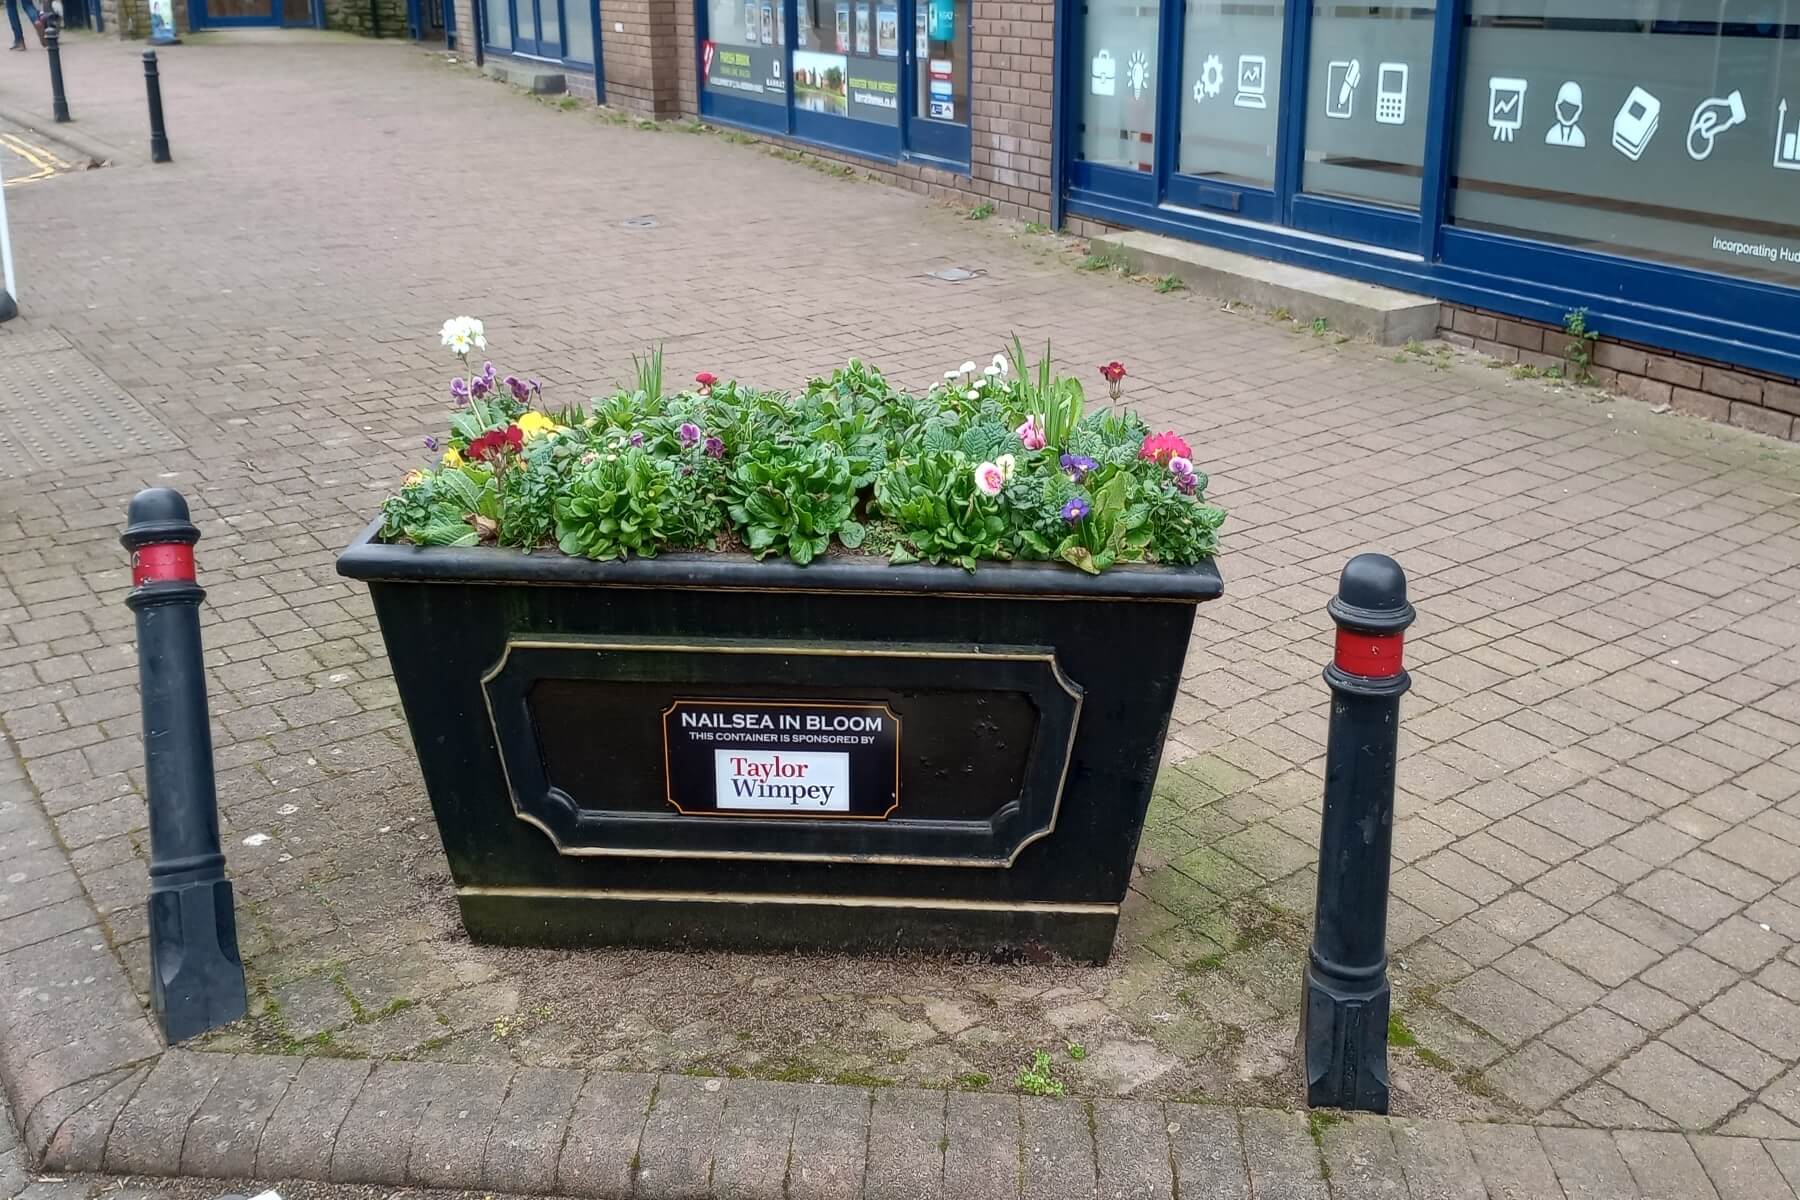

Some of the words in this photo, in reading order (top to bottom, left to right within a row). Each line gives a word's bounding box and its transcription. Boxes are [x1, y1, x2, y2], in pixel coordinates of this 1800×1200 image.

[1713, 236, 1777, 261] Incorporating
[681, 712, 775, 730] NAILSEA
[779, 714, 801, 730] IN
[806, 716, 882, 732] BLOOM
[689, 731, 714, 741] THIS
[715, 732, 778, 743] CONTAINER
[780, 734, 791, 743] IS
[792, 734, 859, 745] SPONSORED
[861, 735, 875, 745] BY
[730, 755, 808, 784] Taylor
[730, 778, 835, 806] Wimpey
